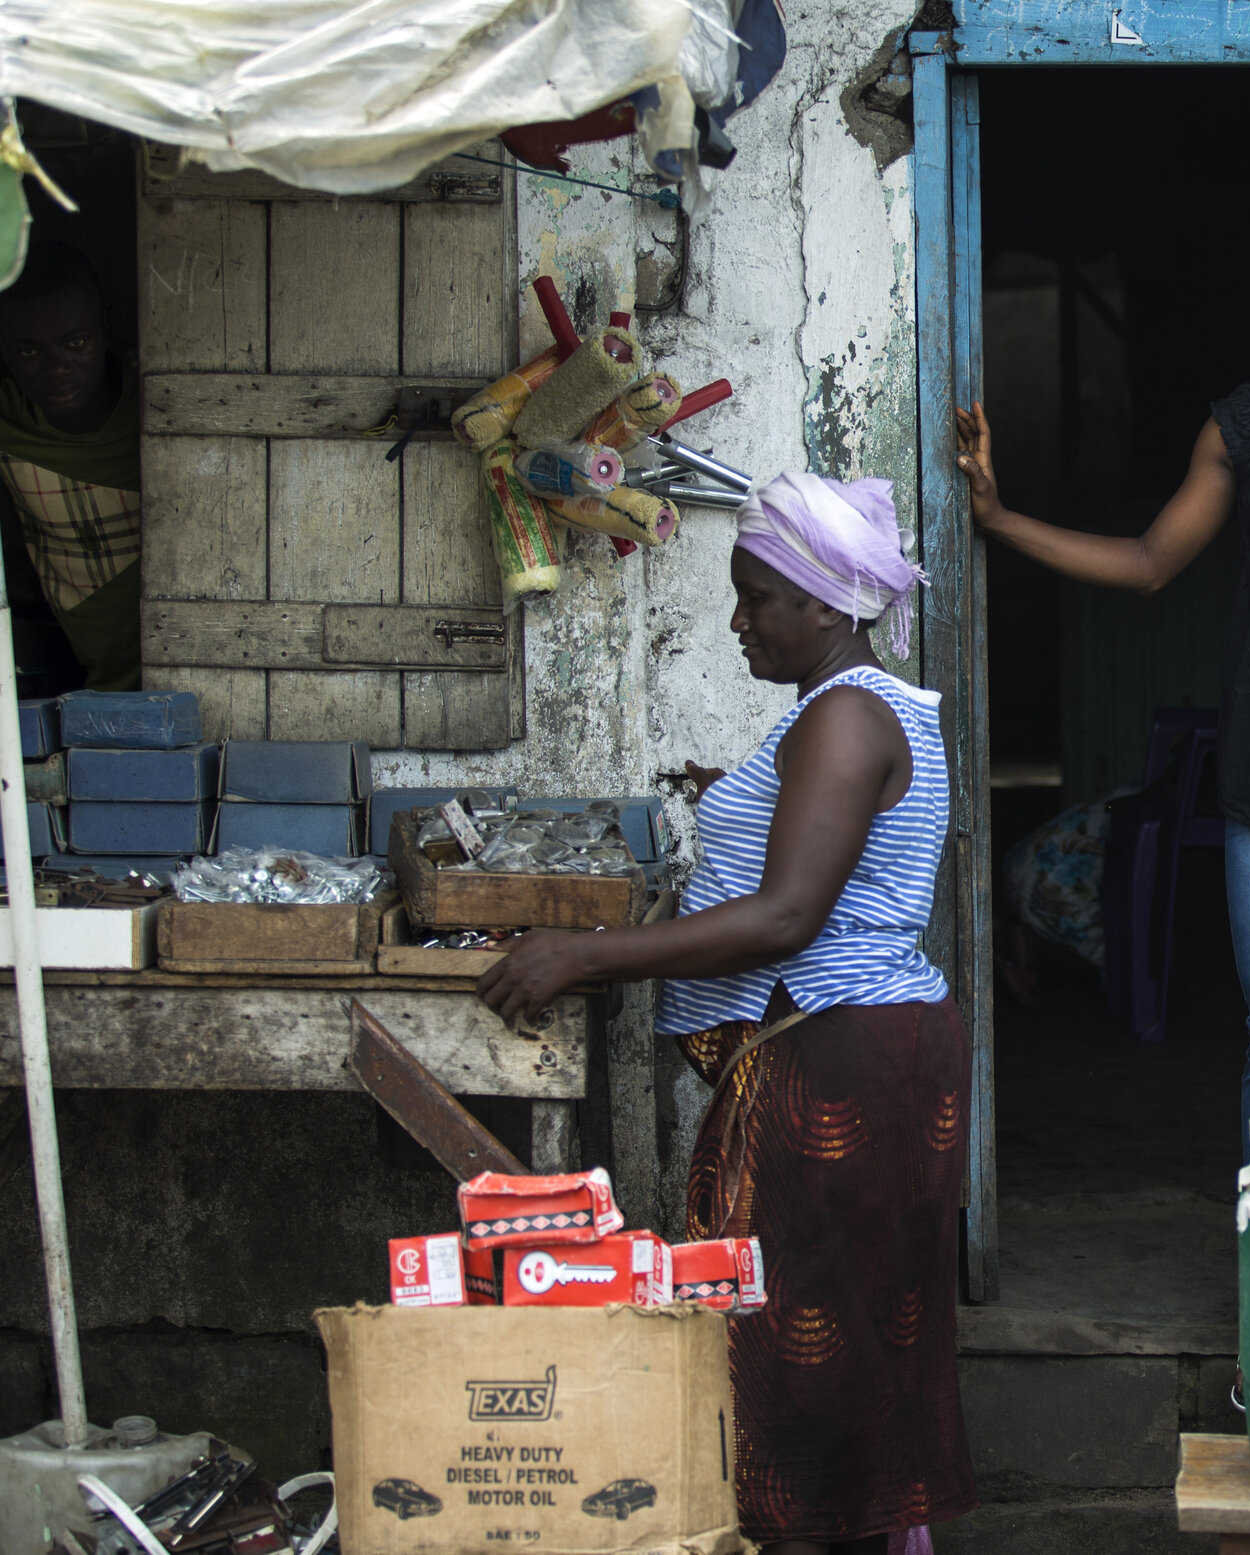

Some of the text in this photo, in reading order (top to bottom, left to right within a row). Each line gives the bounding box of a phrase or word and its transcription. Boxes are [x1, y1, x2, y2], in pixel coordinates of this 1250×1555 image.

[465, 1364, 556, 1422] TEXAS
[461, 1446, 563, 1462] HEAVY DUTY
[446, 1468, 504, 1484] DIESEL
[516, 1469, 578, 1484] PETROL
[468, 1490, 557, 1506] MOTOR OIL
